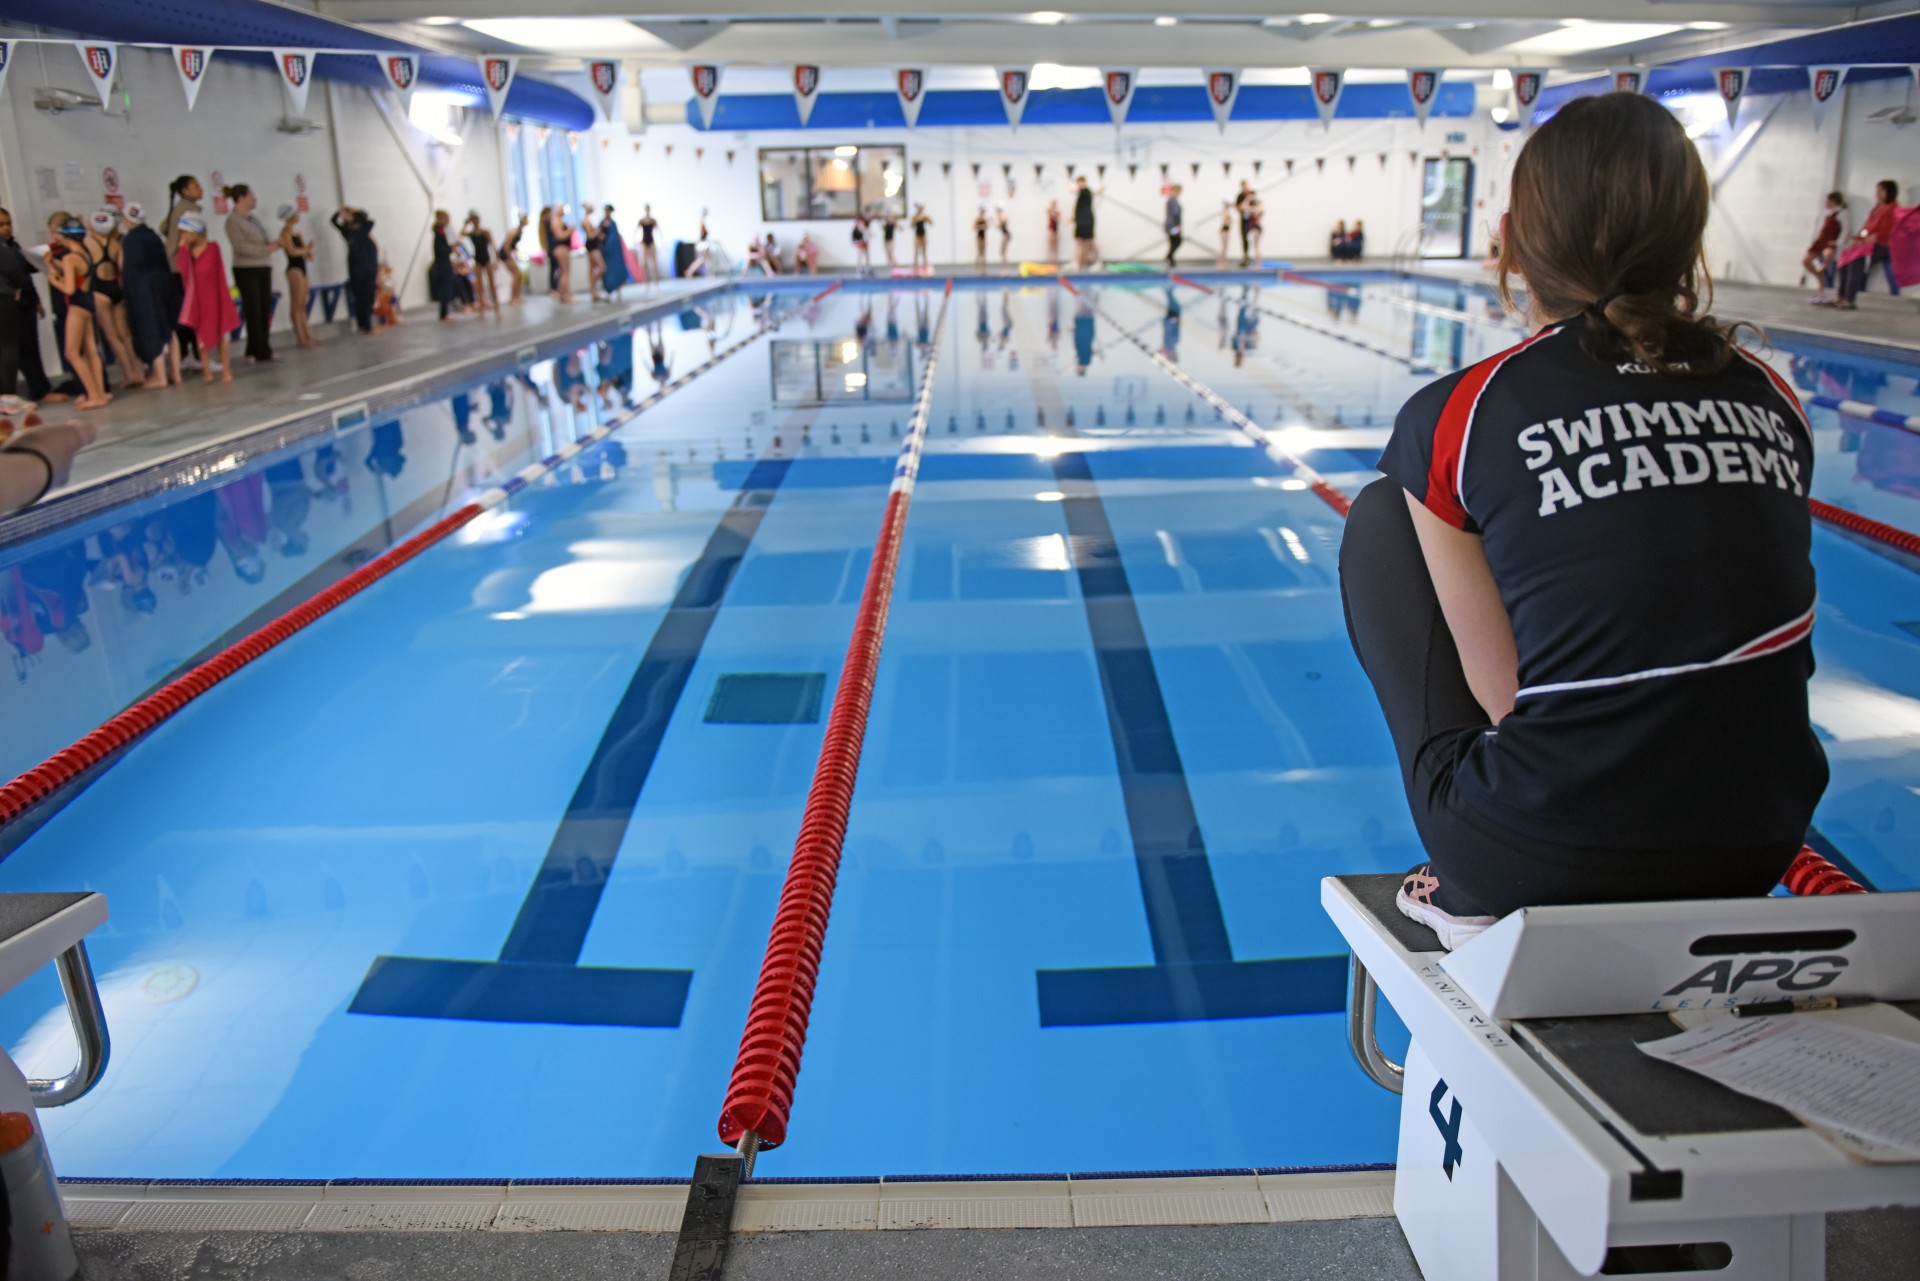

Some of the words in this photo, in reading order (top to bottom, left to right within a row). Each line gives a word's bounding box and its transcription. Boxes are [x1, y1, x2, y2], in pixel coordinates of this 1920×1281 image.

[1517, 400, 1795, 471] SWIMMING
[1538, 442, 1803, 517] ACADEMY
[1662, 955, 1849, 996] APG
[1429, 1077, 1463, 1183] 4
